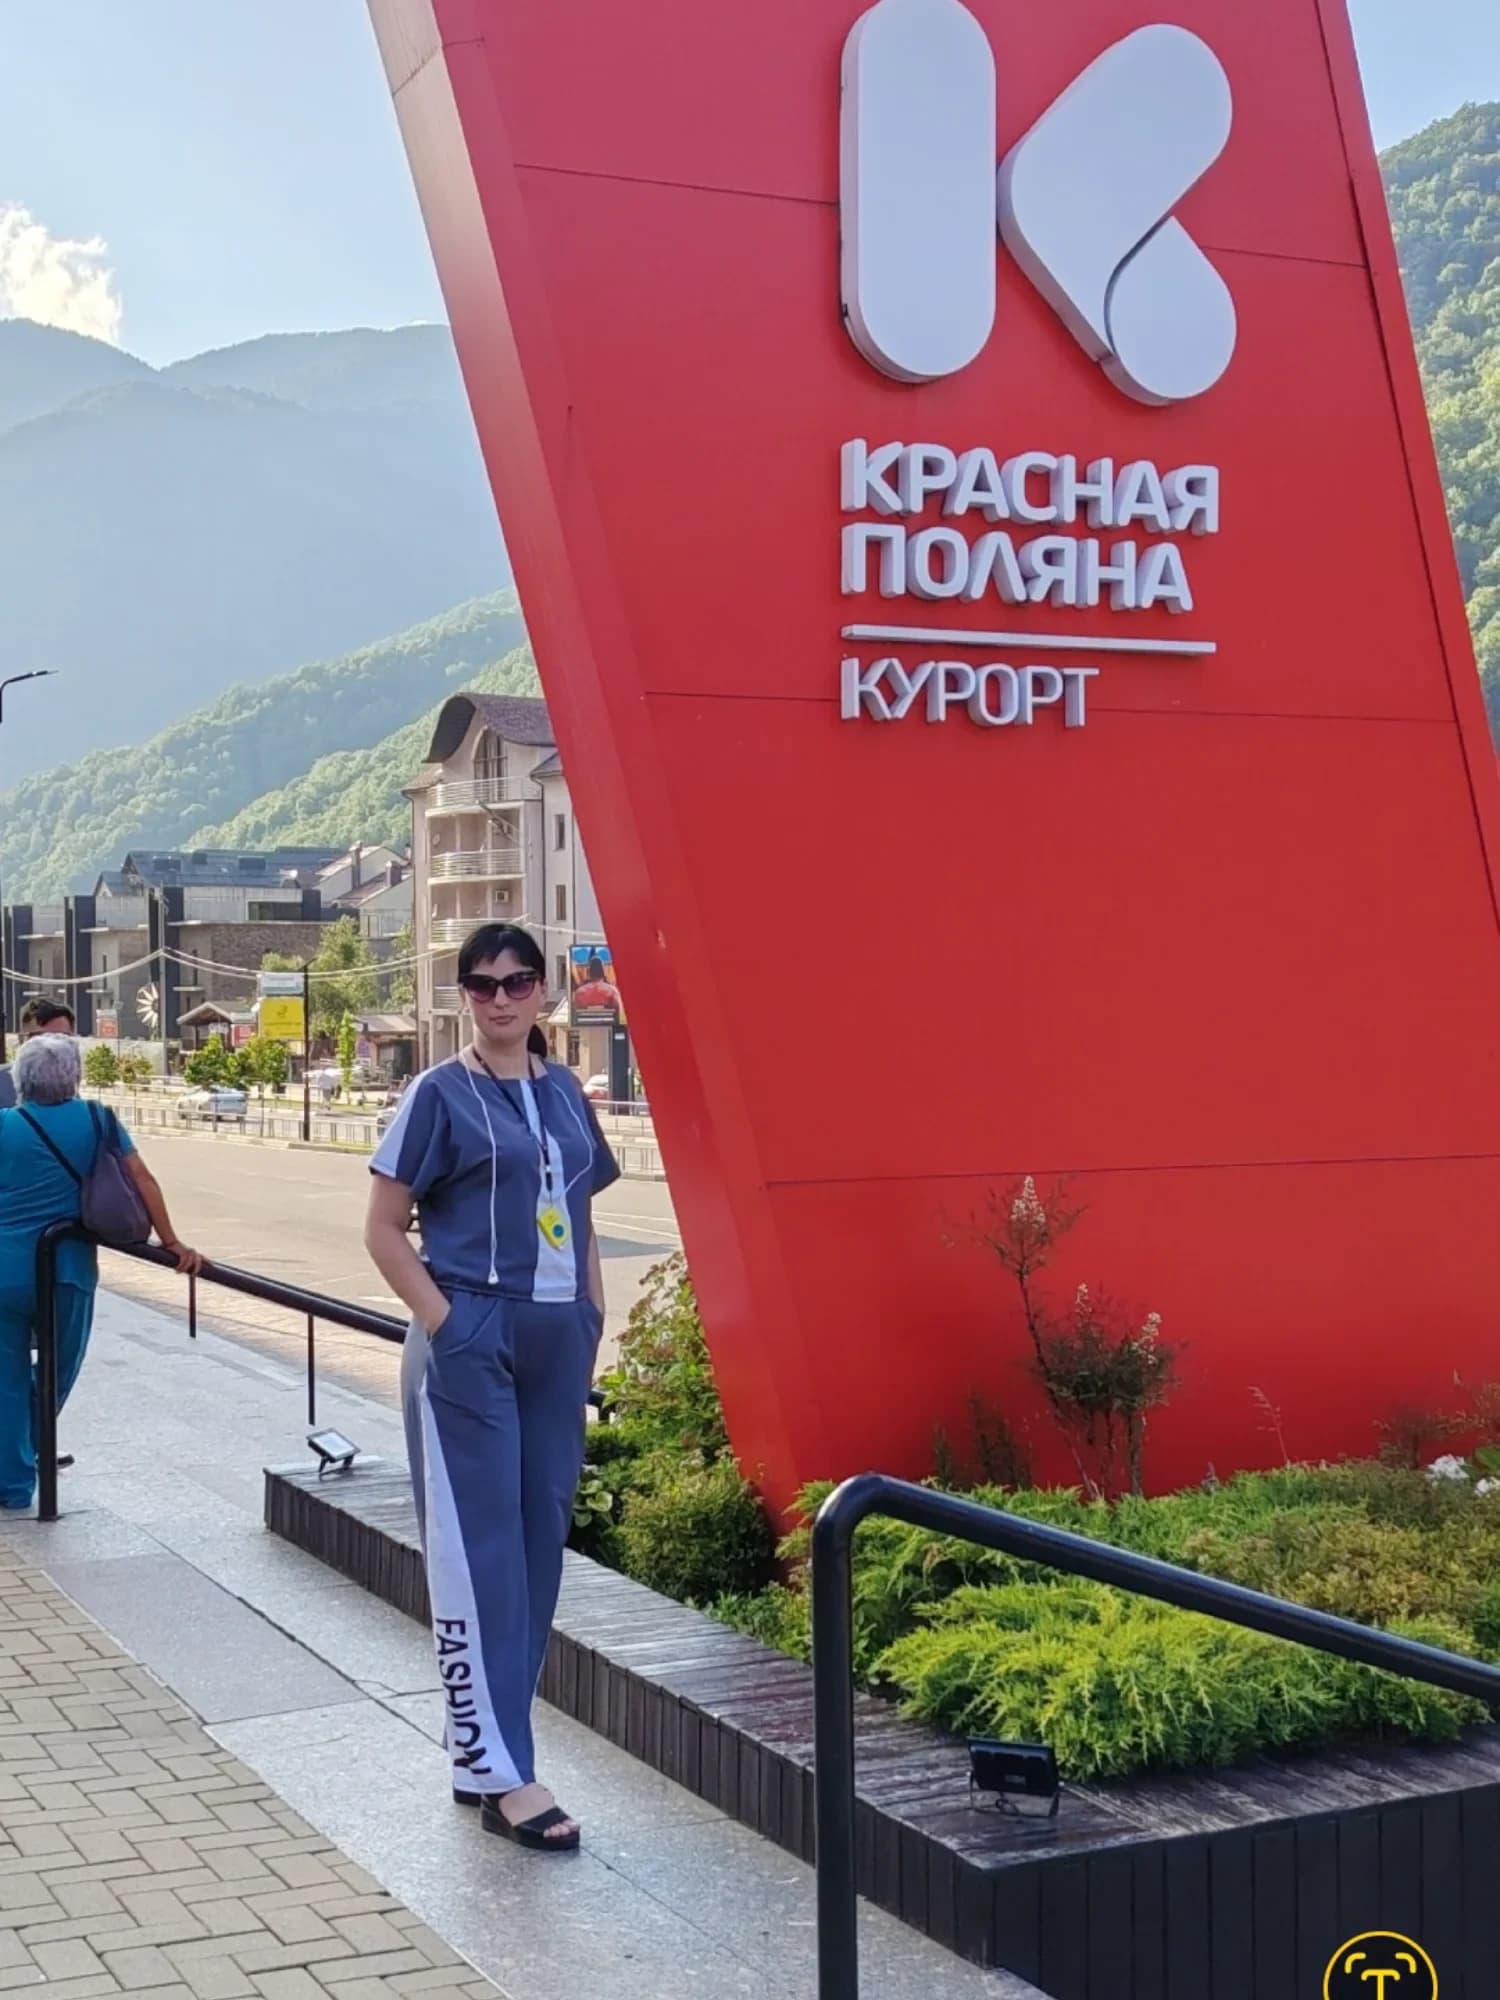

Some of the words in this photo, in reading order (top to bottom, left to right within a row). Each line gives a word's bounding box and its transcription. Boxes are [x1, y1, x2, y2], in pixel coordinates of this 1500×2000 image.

[840, 438, 1220, 534] КРАСНАЯ
[841, 522, 1194, 613] ПОЛЯНА
[841, 657, 1100, 728] КУРОРТ
